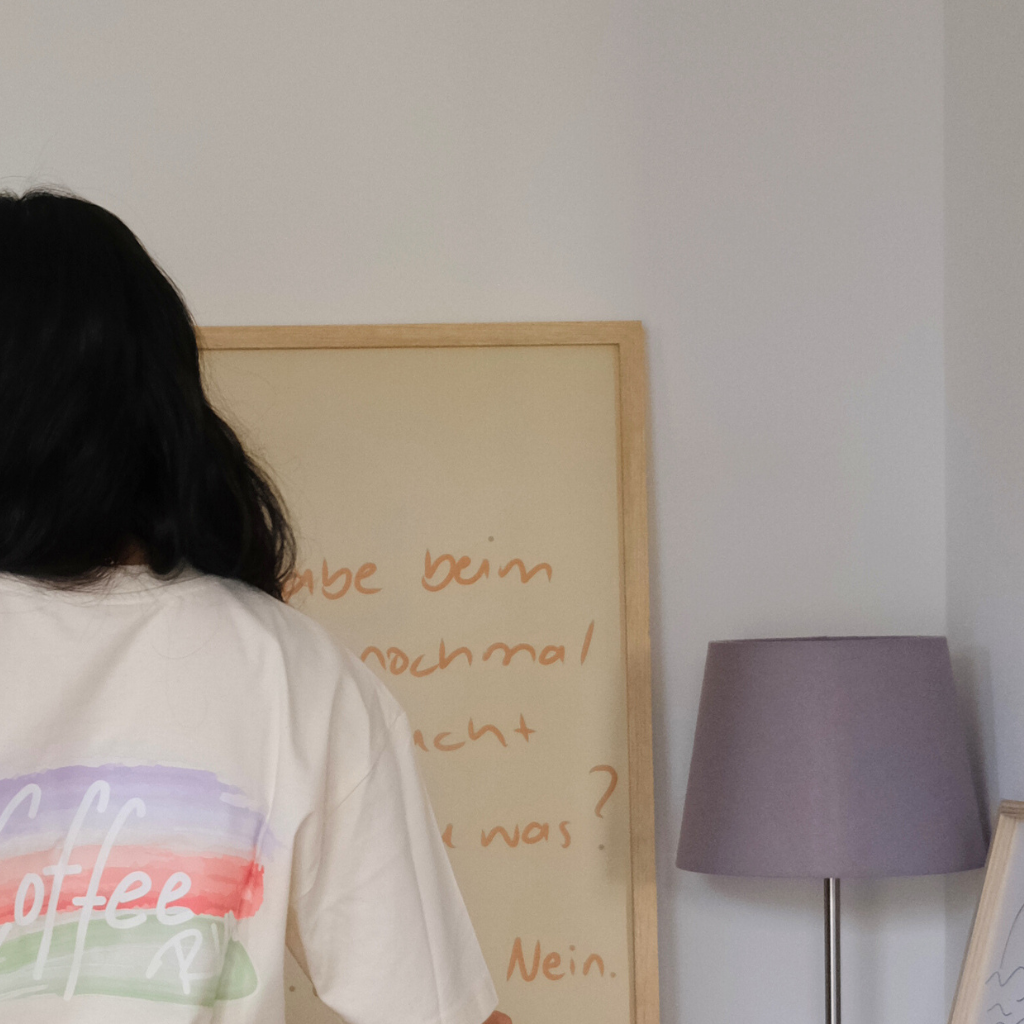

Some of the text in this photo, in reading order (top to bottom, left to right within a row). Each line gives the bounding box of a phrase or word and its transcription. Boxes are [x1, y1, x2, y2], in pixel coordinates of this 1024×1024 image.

[281, 535, 553, 603] abe beim
[360, 619, 595, 678] nochmal
[506, 936, 617, 983] Nein.
